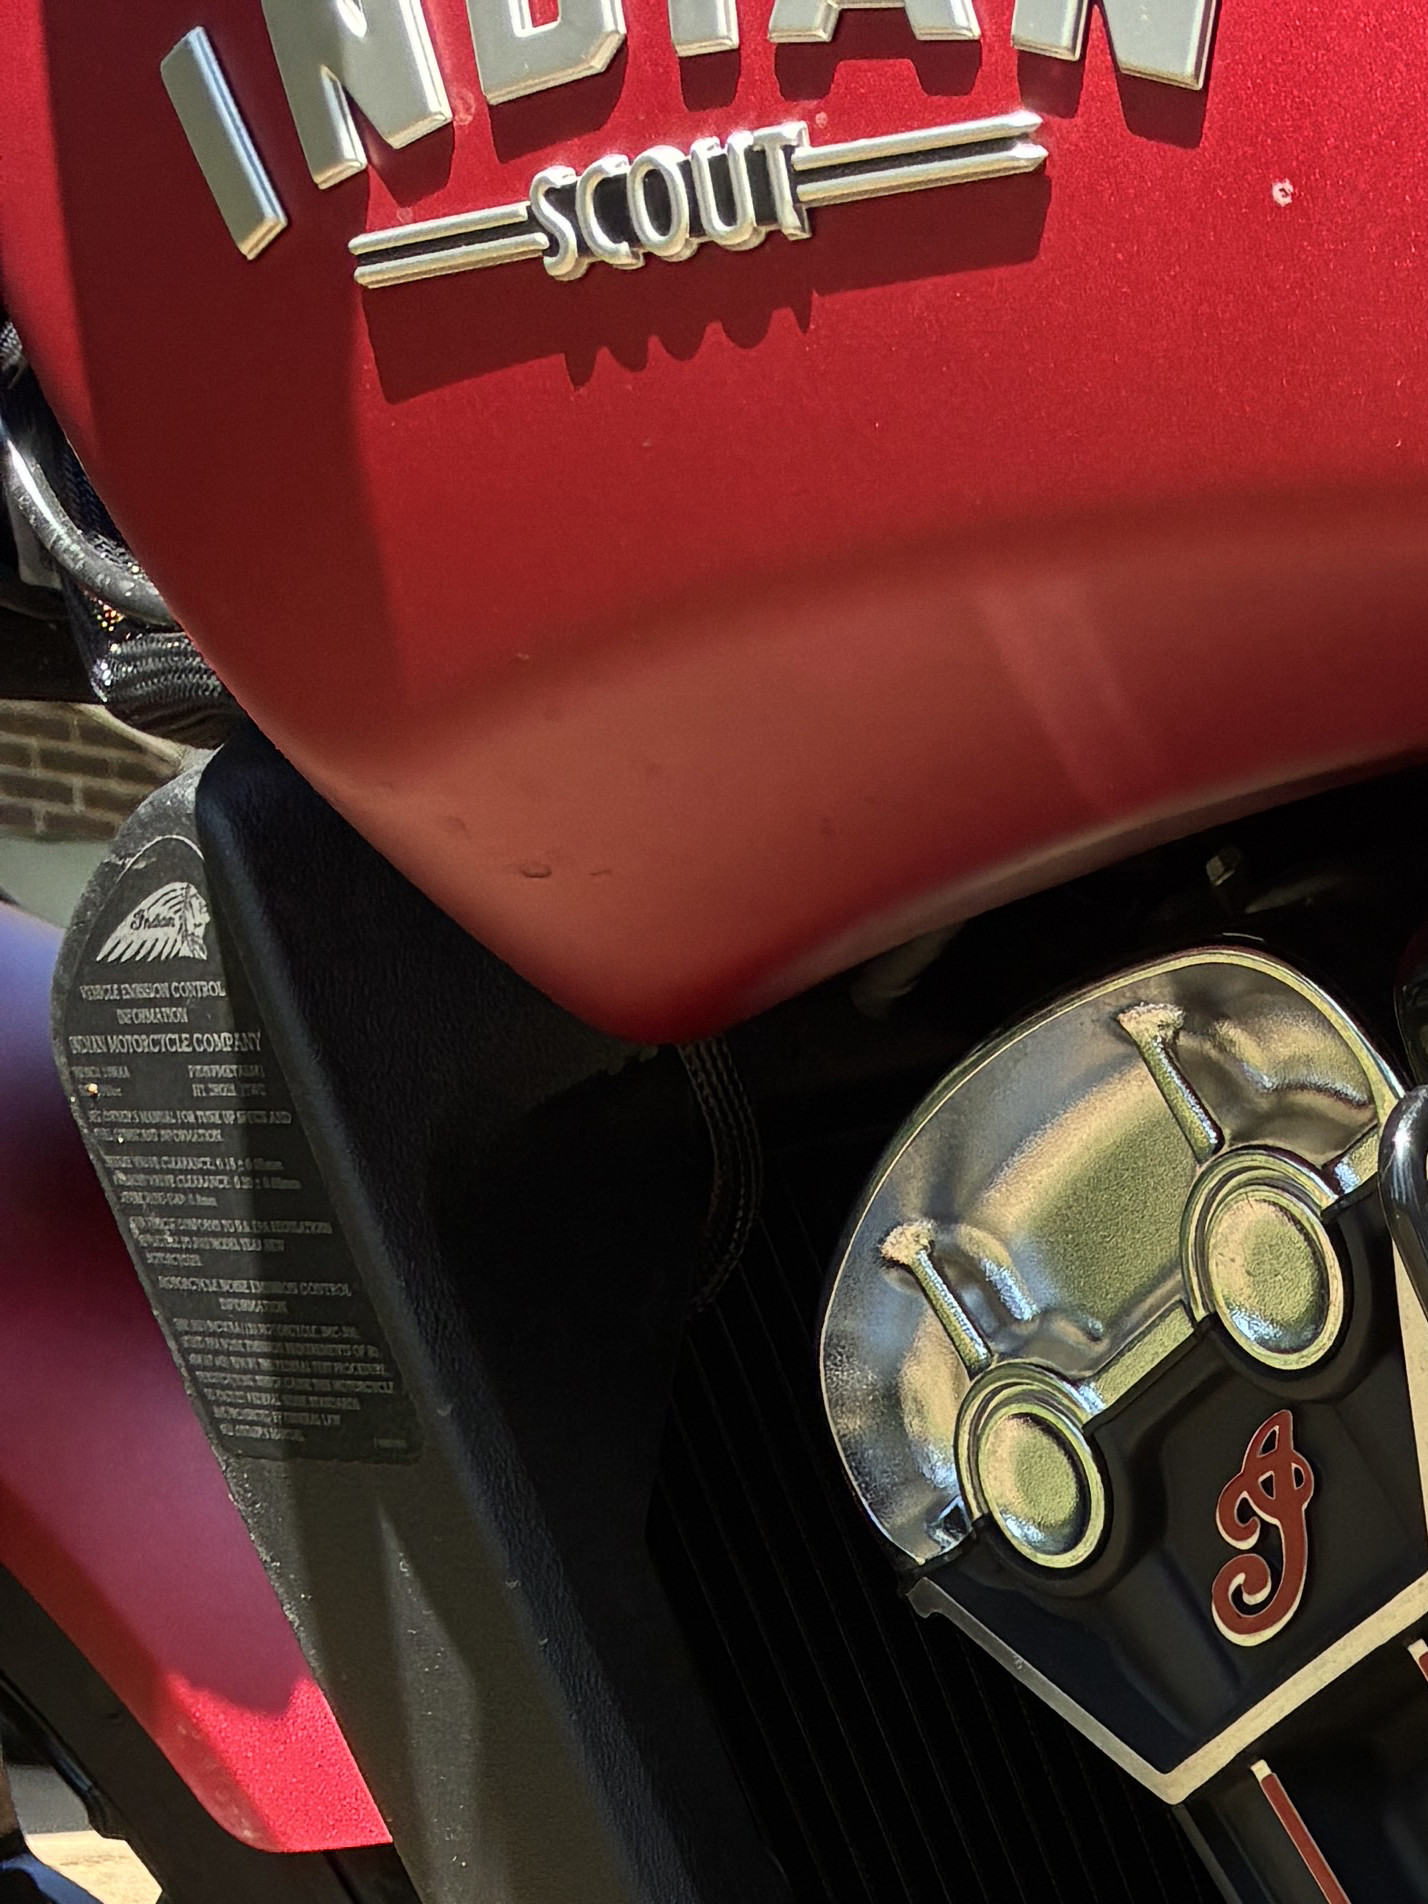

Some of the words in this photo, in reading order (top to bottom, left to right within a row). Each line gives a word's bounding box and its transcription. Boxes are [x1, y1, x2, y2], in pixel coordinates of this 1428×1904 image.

[530, 121, 811, 281] SCOUT
[171, 981, 227, 998] CONTROL
[108, 1033, 192, 1053] MOTORCYCLE
[192, 1031, 262, 1052] COMPANY
